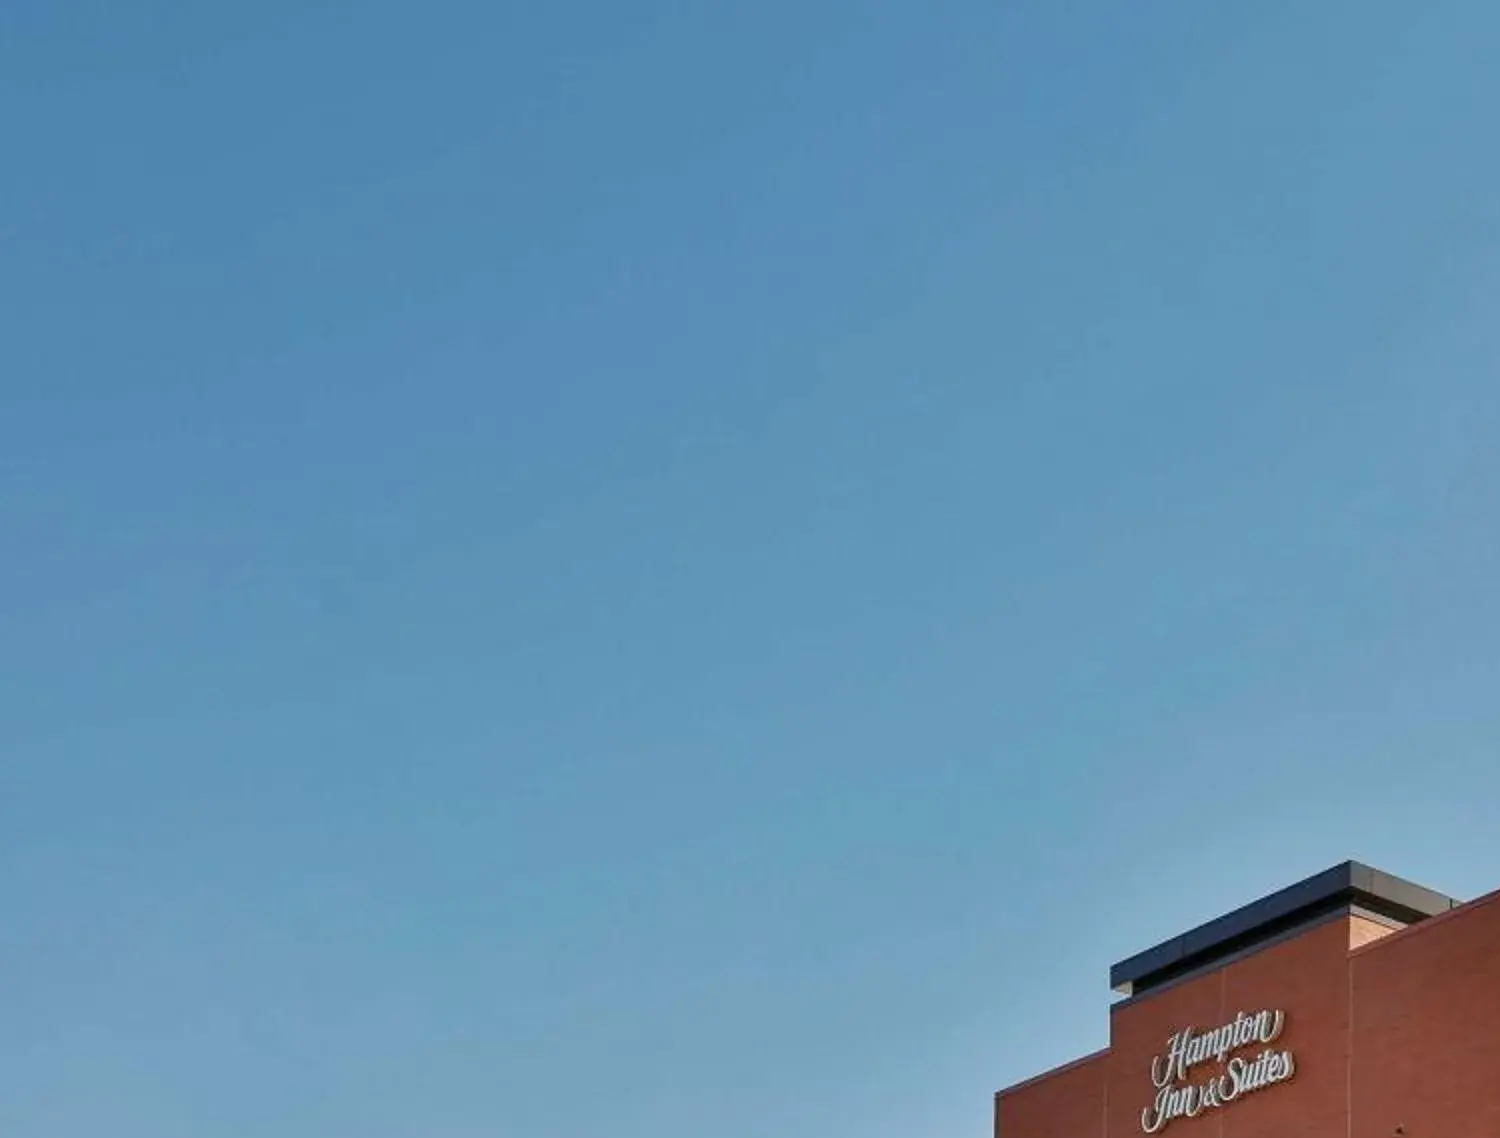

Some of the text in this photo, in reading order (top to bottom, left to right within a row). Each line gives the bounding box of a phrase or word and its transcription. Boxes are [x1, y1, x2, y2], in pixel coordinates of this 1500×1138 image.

[1152, 1008, 1284, 1087] Hampton
[1141, 1049, 1295, 1133] Inn & Suites
